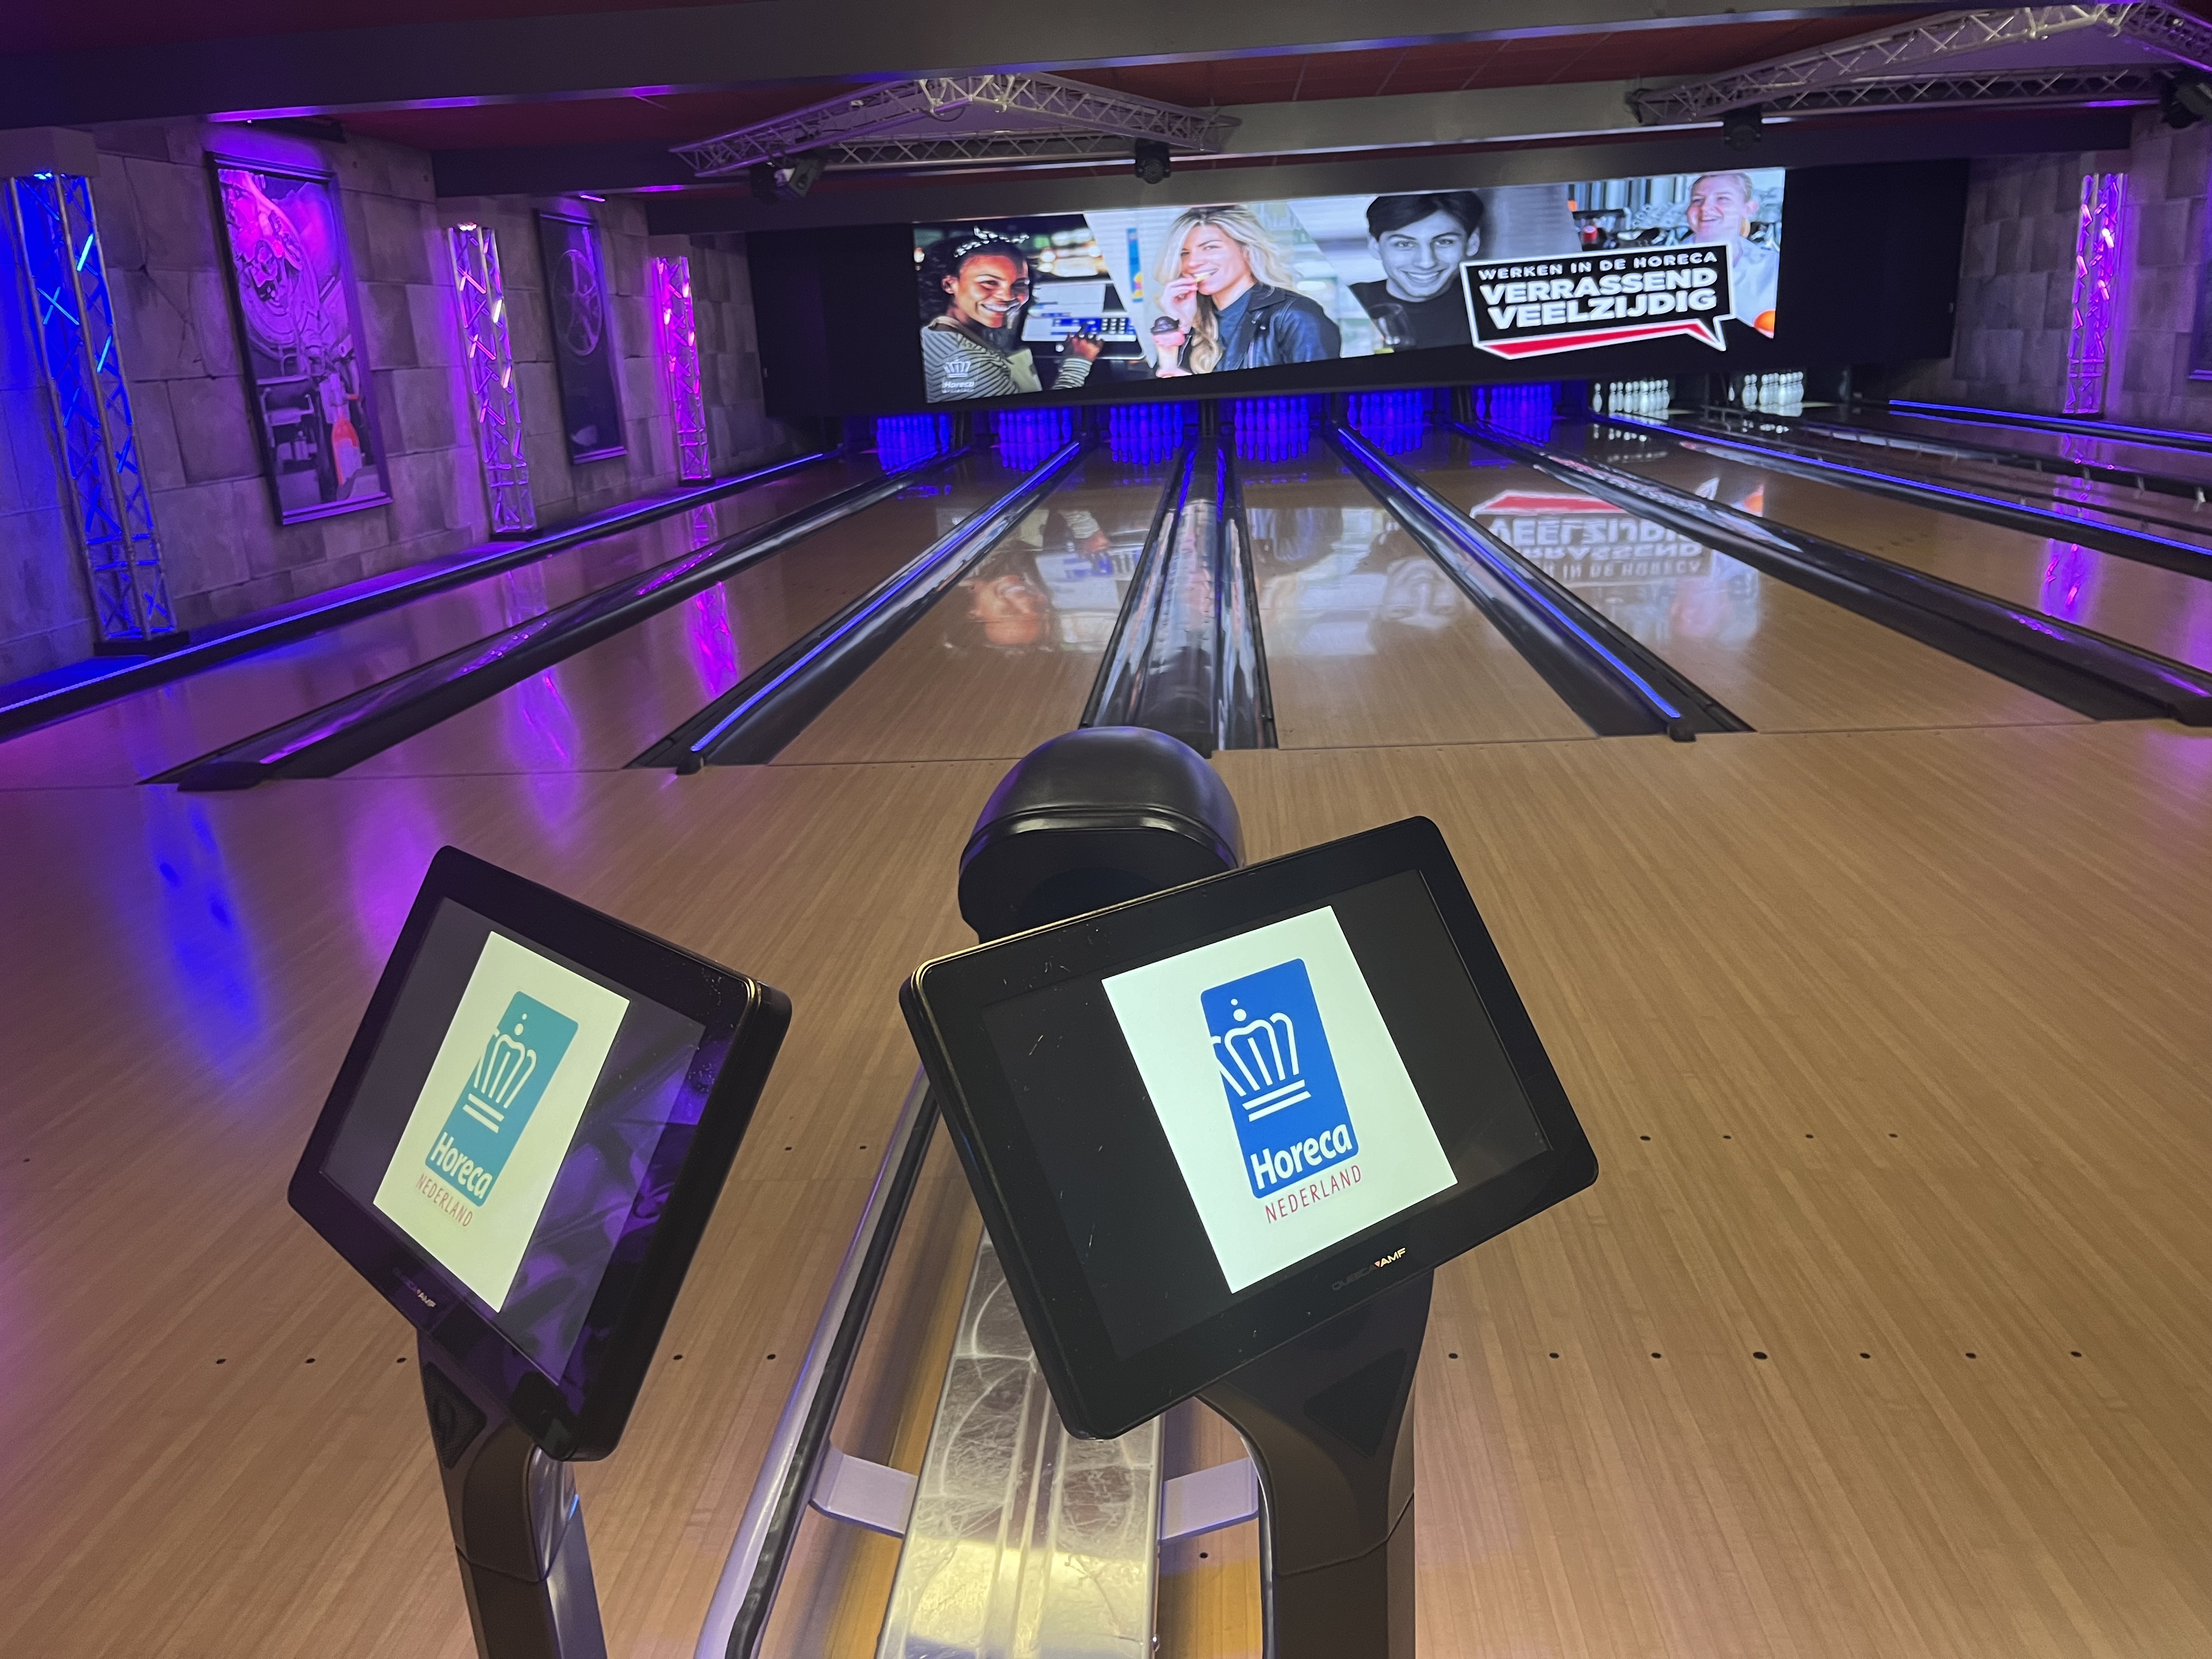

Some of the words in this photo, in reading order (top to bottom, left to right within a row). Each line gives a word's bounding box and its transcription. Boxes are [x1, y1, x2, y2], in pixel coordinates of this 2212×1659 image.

[1479, 263, 1563, 280] WERKEN
[1571, 261, 1592, 274] IN
[1600, 258, 1626, 271] DE
[1633, 251, 1717, 269] HORECA
[1480, 267, 1718, 305] VERRASSEND
[1487, 288, 1717, 329] VEELZIJDIG
[430, 1132, 493, 1199] Horeca
[1250, 1124, 1353, 1190] Horeca
[416, 1173, 473, 1227] NEDERLAND
[1265, 1164, 1362, 1224] NEDERLAND
[1380, 1248, 1406, 1267] AMF
